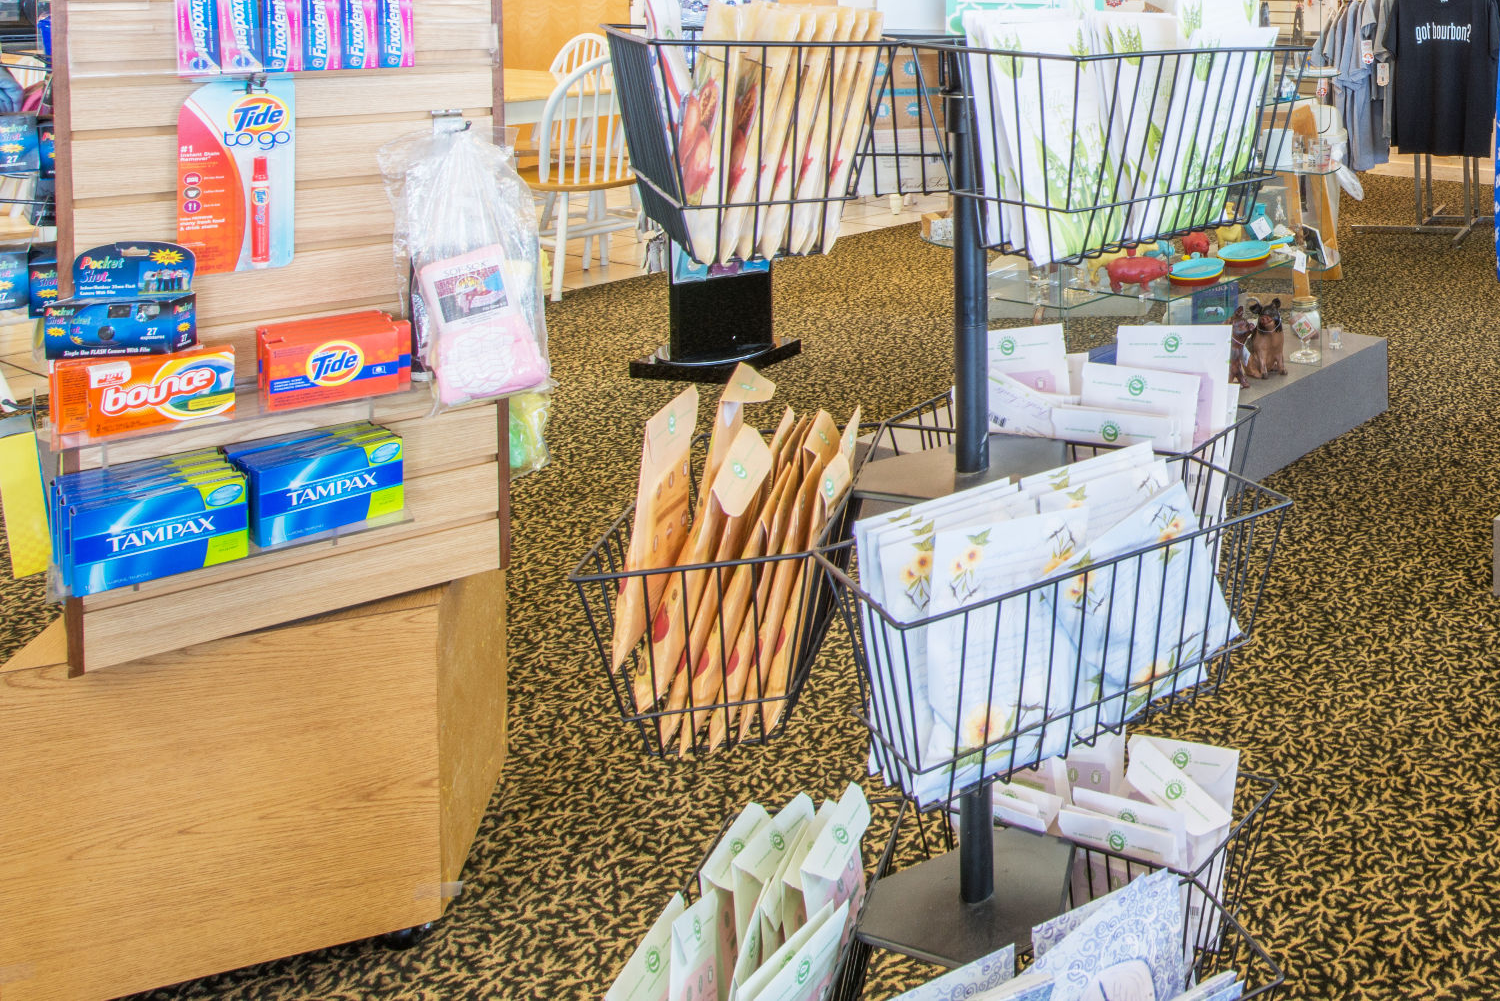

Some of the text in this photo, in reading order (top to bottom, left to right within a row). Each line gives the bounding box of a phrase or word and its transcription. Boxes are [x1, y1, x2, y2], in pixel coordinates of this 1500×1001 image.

[1415, 21, 1473, 45] got bourbon?
[233, 103, 284, 132] Tide
[180, 144, 194, 153] #1
[223, 130, 292, 151] to go
[80, 256, 126, 271] Pocket
[46, 307, 75, 317] Pocket
[147, 327, 158, 336] 27
[64, 350, 80, 358] Single
[311, 350, 358, 382] Tide
[102, 368, 212, 415] bounce
[286, 471, 377, 507] TAMPAX
[106, 515, 217, 553] TAMPAX
